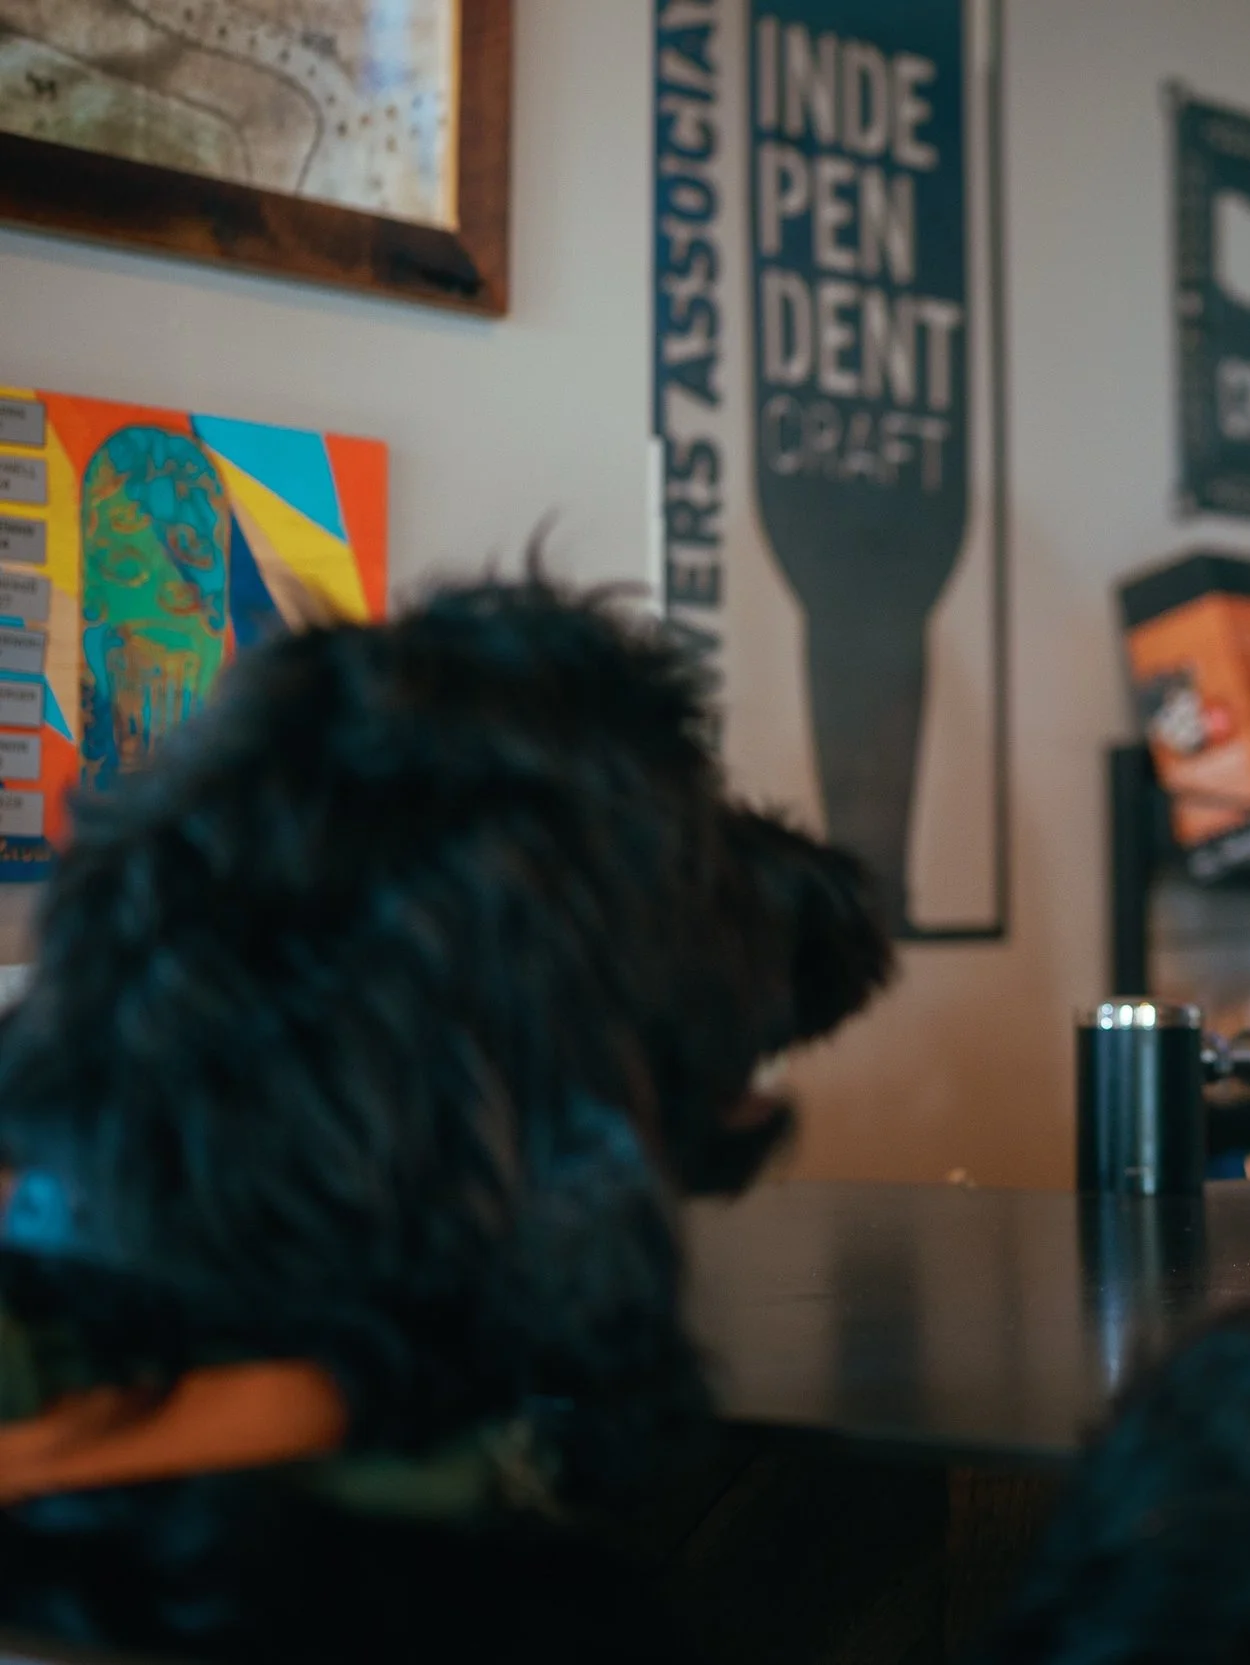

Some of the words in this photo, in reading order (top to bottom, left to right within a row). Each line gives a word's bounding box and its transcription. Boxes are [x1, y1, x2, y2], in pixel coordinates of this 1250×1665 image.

[755, 14, 938, 172] INDE
[656, 0, 722, 411] ASSOCIA
[757, 137, 915, 285] PEN
[760, 264, 962, 412] DENT
[761, 395, 952, 491] CRAFT
